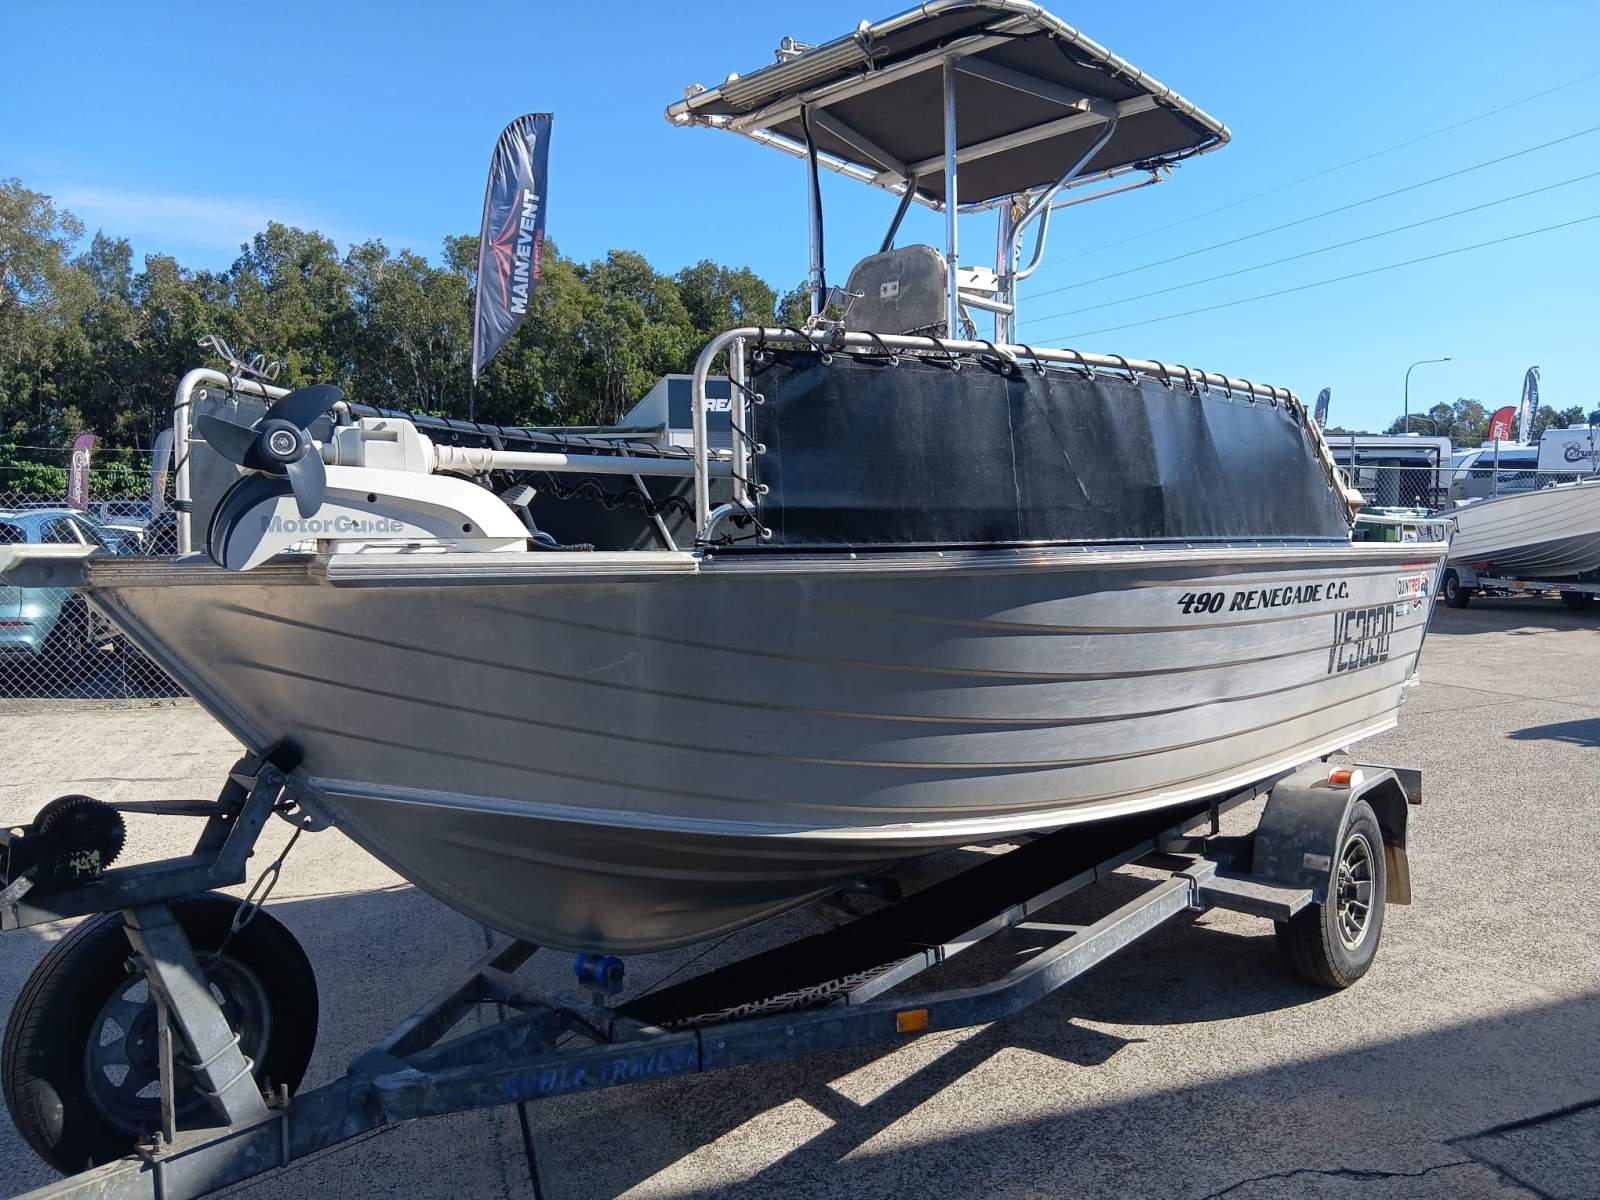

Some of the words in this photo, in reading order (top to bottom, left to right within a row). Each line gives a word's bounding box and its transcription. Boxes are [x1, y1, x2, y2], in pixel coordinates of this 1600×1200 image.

[516, 189, 541, 257] EVENT
[511, 260, 529, 314] MAIN
[260, 515, 404, 533] MotorGuide
[1177, 592, 1226, 615] 490
[1228, 584, 1323, 612] RENEGADE
[1325, 581, 1349, 600] C.C.
